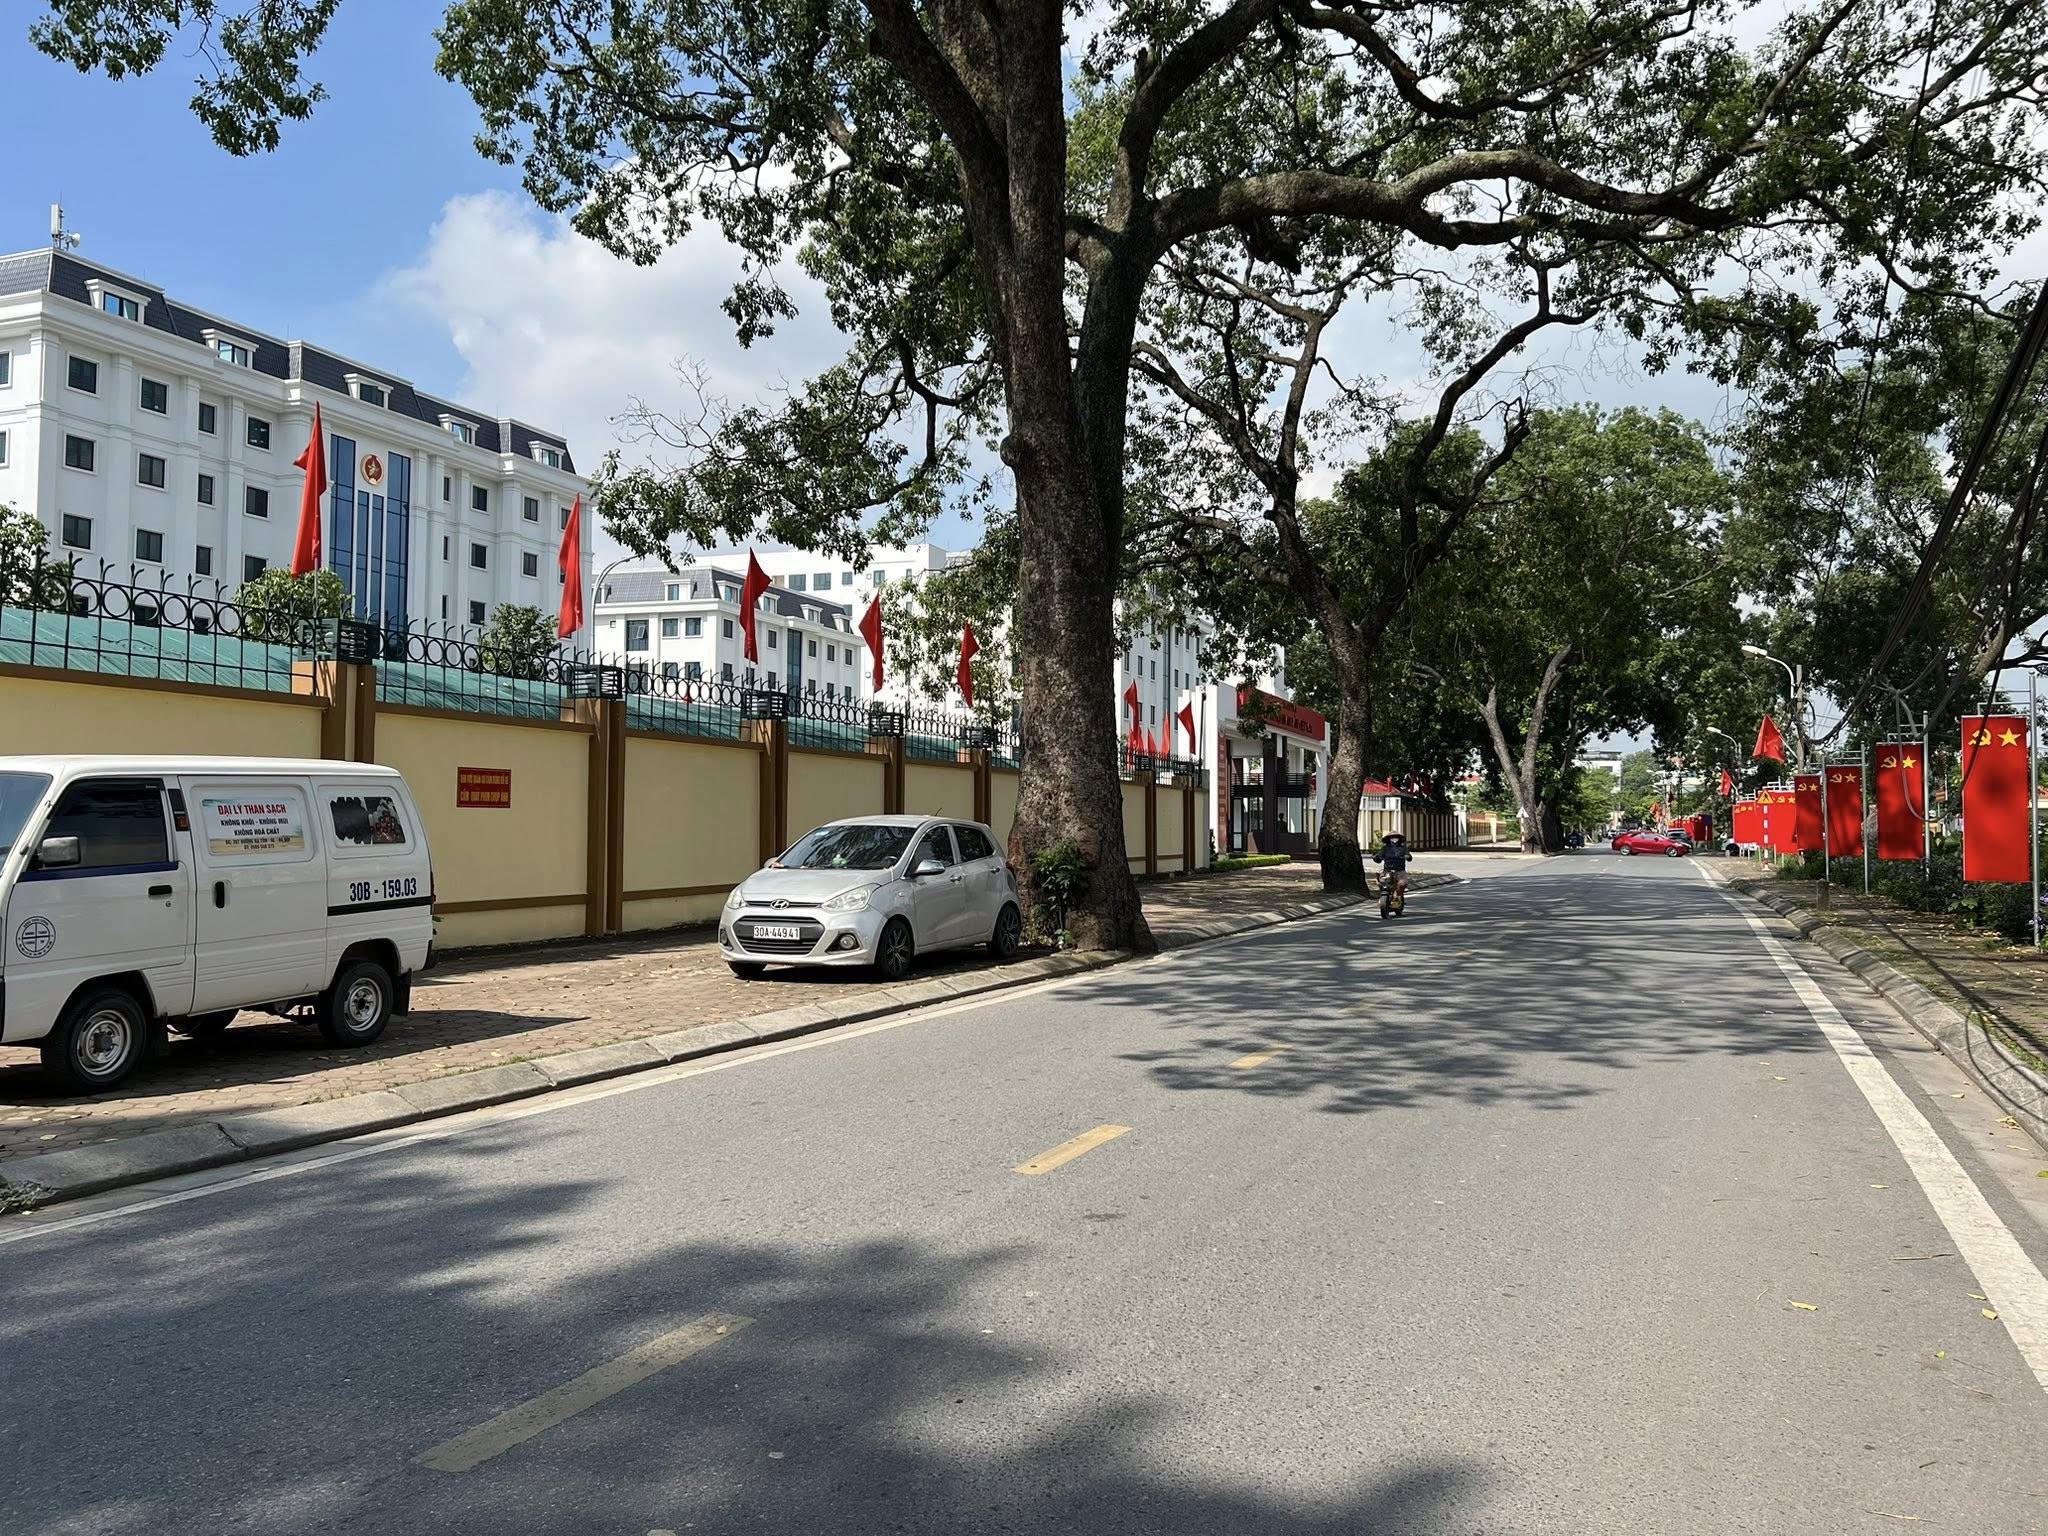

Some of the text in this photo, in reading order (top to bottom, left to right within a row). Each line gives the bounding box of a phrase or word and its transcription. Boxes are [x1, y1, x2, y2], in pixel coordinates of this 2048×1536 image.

[217, 803, 287, 817] ĐẠI LÝ THAN SẠCH
[220, 818, 240, 826] KHÔNG
[259, 817, 277, 825] KHÔNG
[234, 828, 254, 836] KHÔNG
[349, 881, 371, 902] 30B
[382, 877, 417, 899] 159.03
